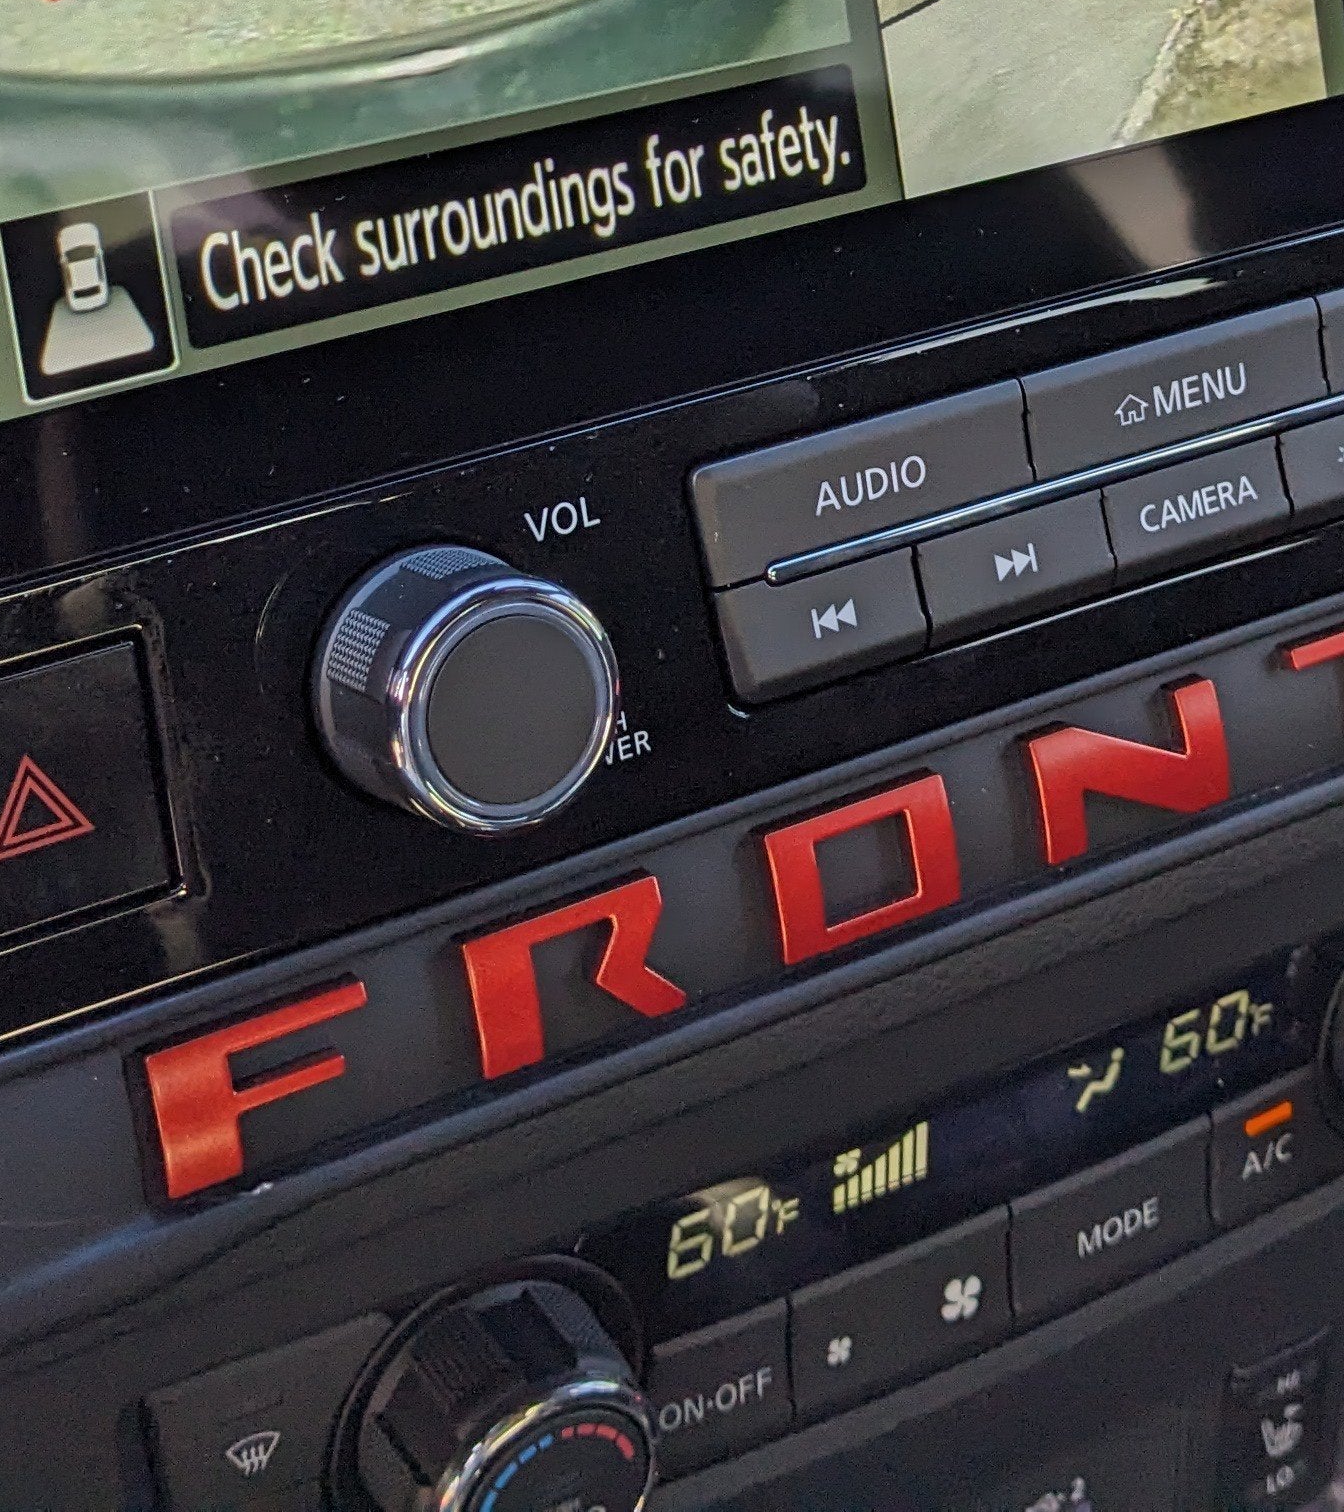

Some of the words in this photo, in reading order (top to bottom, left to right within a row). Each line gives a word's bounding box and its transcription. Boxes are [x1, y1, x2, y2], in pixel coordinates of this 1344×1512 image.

[200, 212, 344, 312] Check
[356, 160, 636, 276] surroundings
[644, 133, 706, 208] for
[720, 104, 852, 188] safety.
[1152, 361, 1248, 419] MENU
[815, 455, 927, 518] AUDIO
[1139, 475, 1259, 533] CAMERA
[523, 496, 602, 543] VOL
[1241, 1138, 1294, 1181] A/C
[1076, 1195, 1160, 1258] MODE
